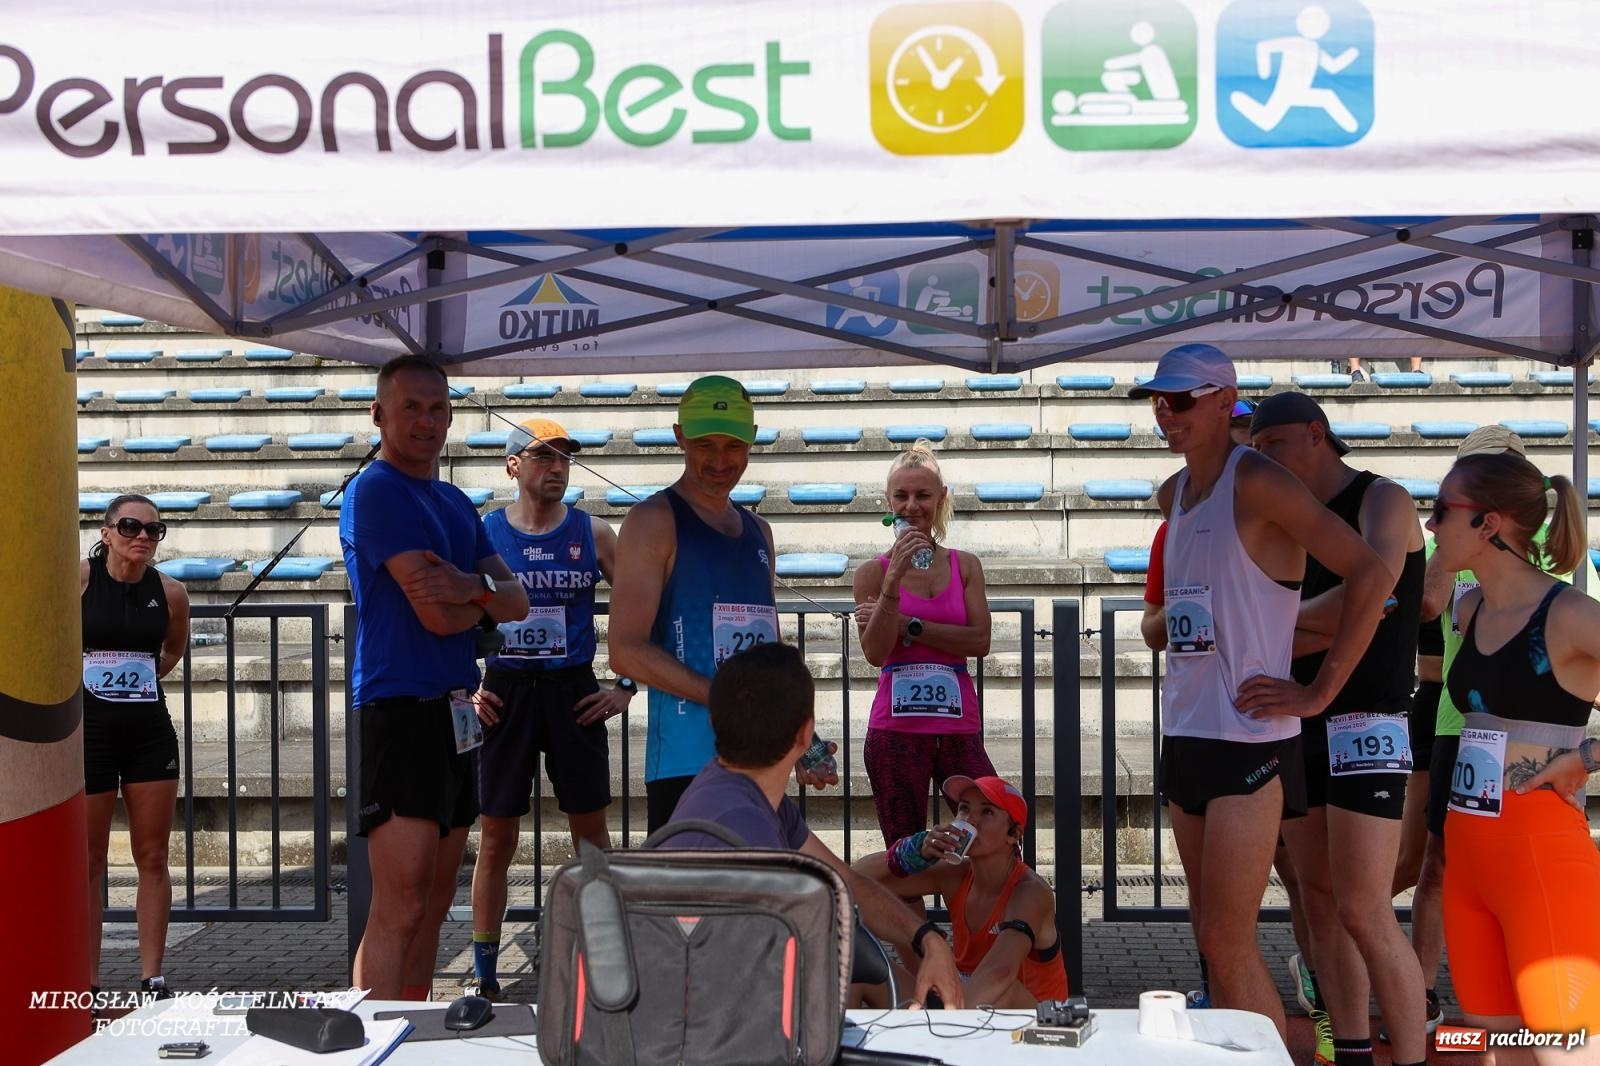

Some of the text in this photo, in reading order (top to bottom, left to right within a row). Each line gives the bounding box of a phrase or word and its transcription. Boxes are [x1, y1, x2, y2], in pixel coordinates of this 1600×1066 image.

[514, 629, 547, 645] 163
[102, 671, 140, 688] 242
[910, 684, 947, 702] 238
[1467, 731, 1498, 741] GRANIC
[1352, 735, 1395, 757] 193
[1245, 756, 1280, 785] KIPRUN
